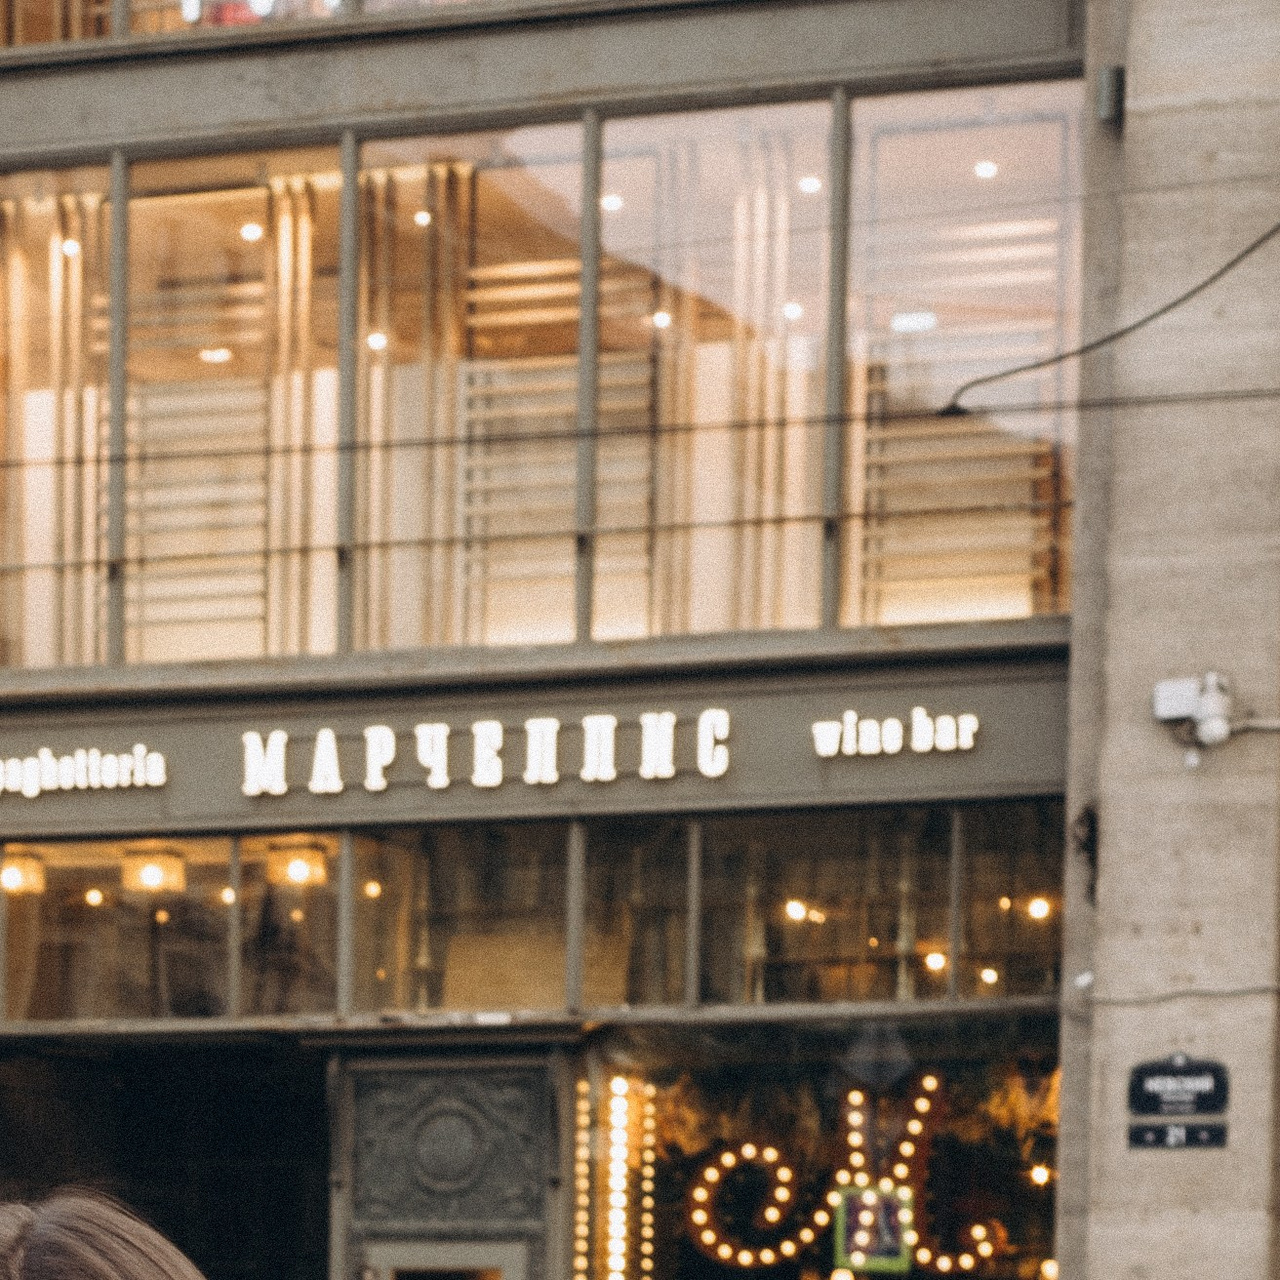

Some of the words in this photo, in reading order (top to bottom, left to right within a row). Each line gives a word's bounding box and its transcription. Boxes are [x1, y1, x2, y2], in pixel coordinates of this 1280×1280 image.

[241, 708, 730, 796] МАРЧЕЛЛИС
[811, 709, 903, 757] wine
[910, 706, 979, 753] bar
